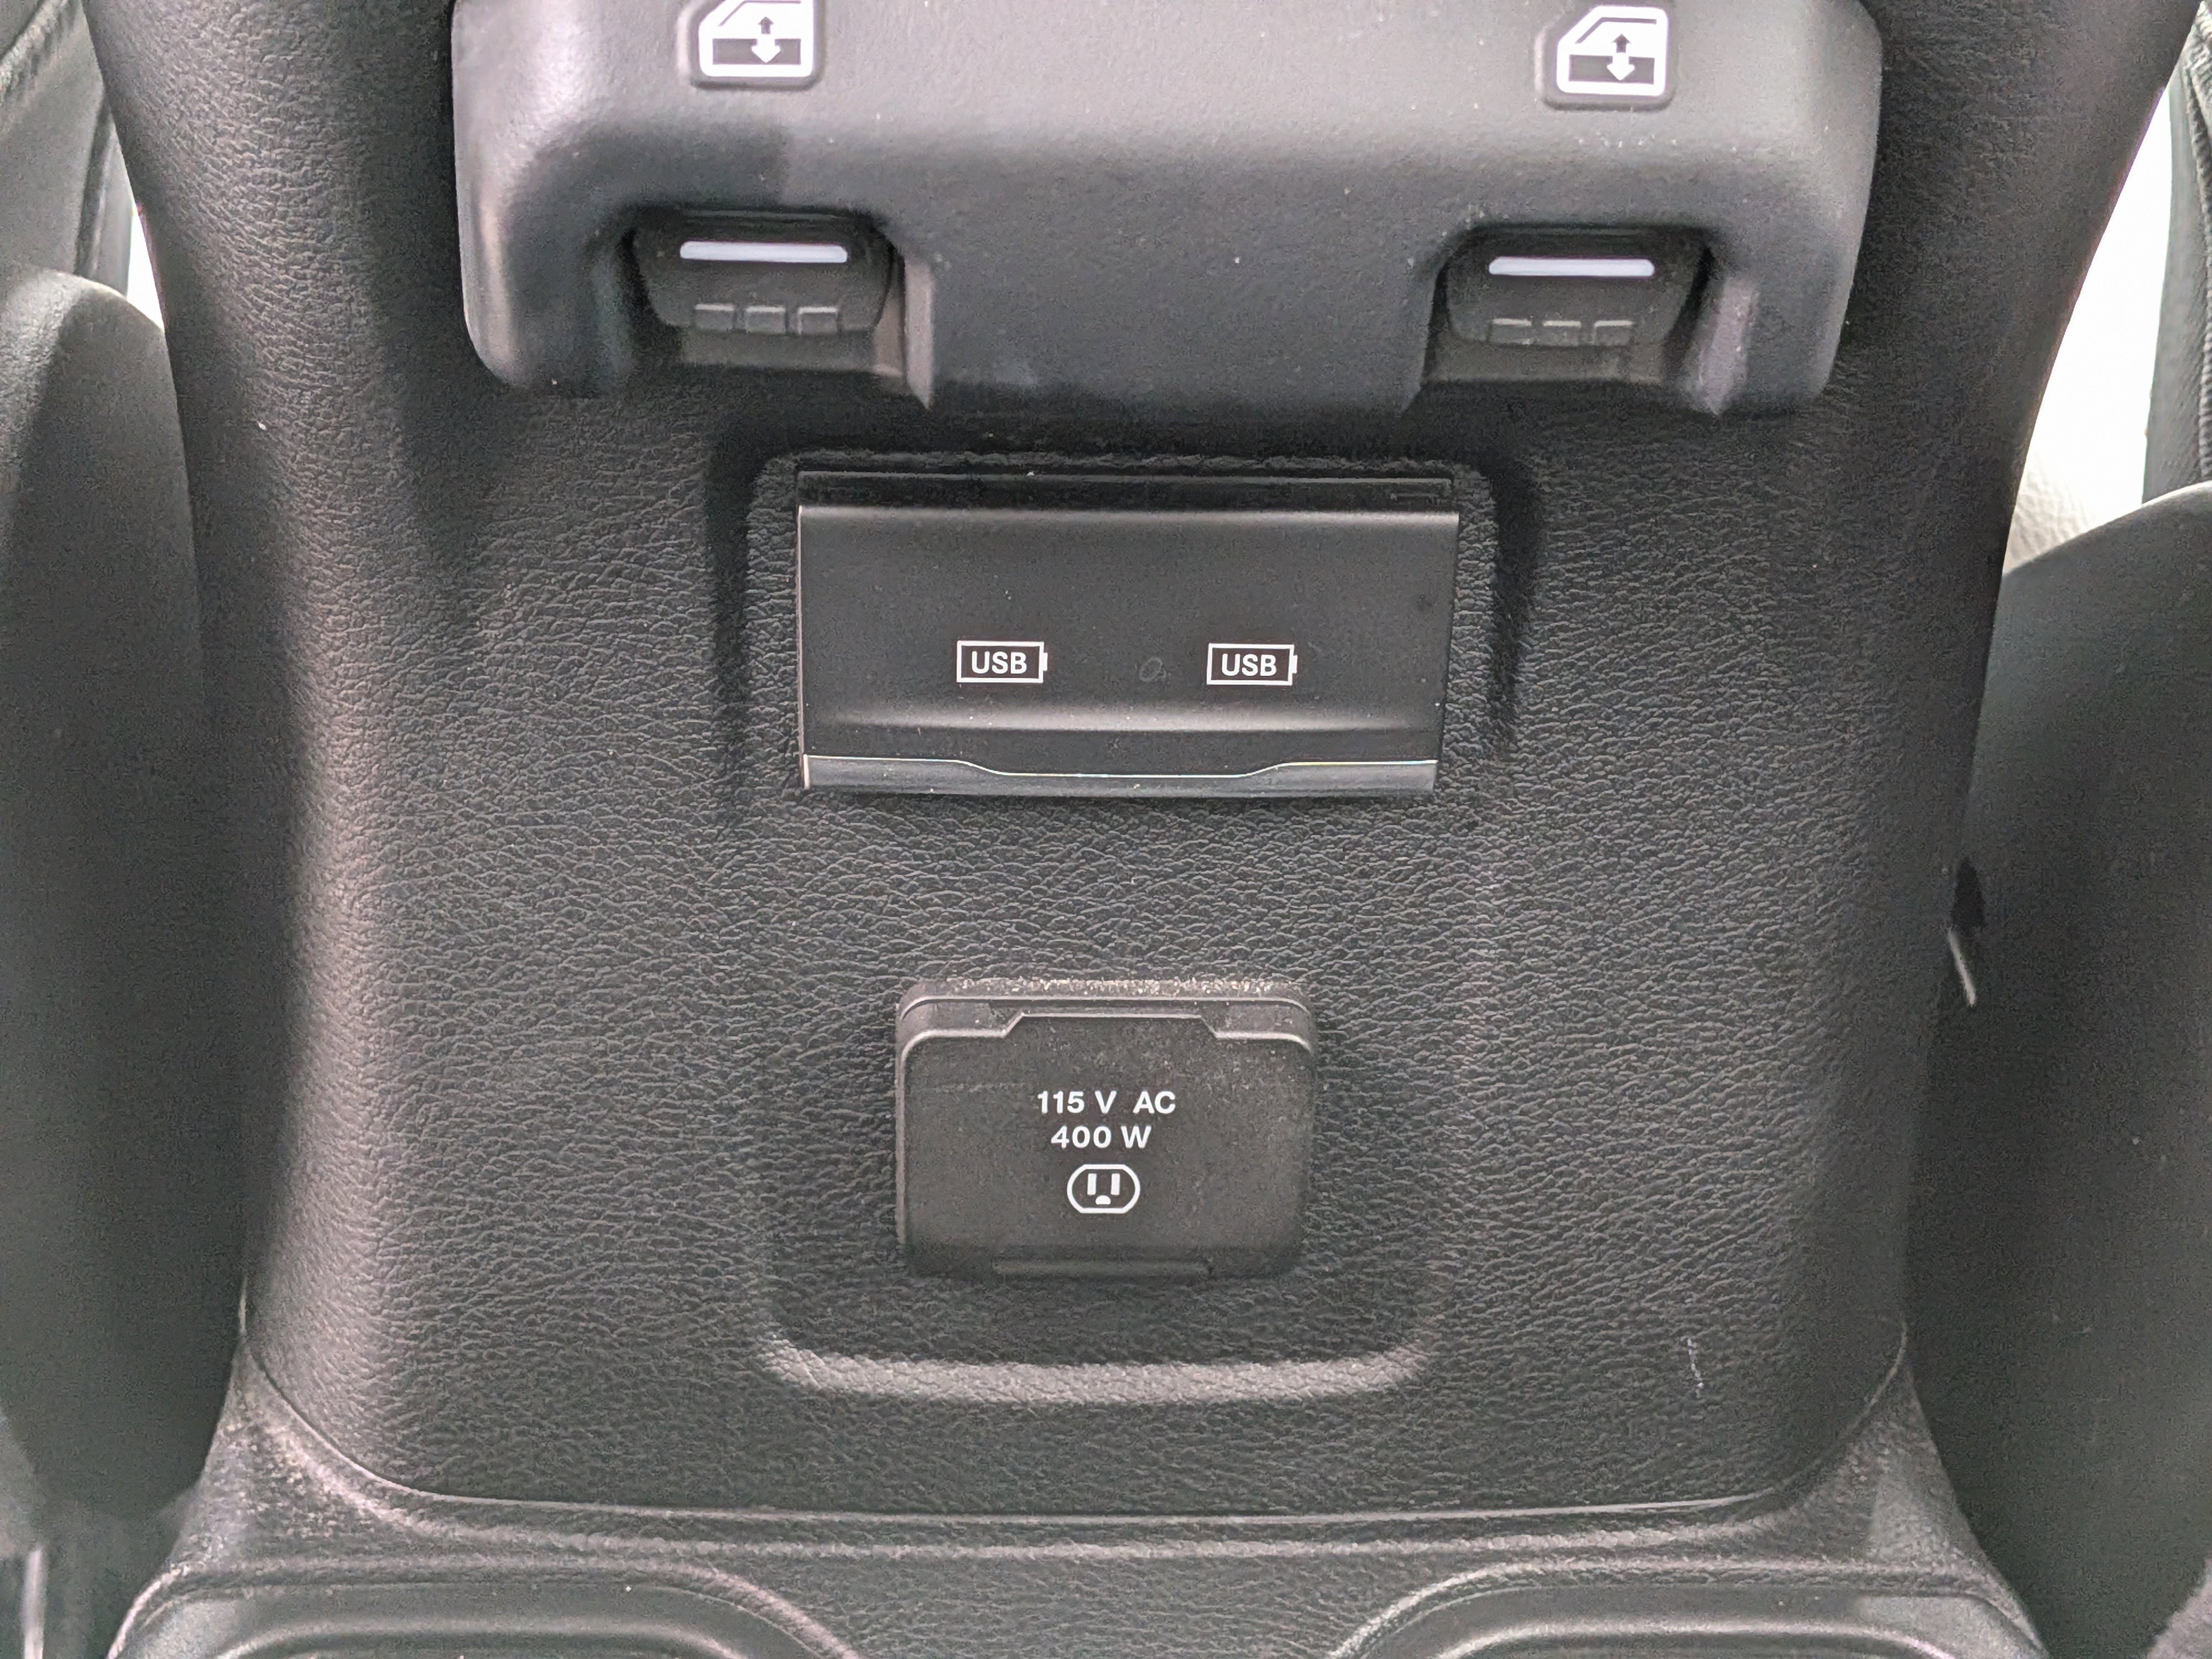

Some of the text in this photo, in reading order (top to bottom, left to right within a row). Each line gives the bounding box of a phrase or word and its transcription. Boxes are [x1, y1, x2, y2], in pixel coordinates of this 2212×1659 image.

[971, 650, 1027, 675] USB
[1221, 653, 1278, 677] USB
[1036, 1089, 1177, 1115] 115 V AC
[1050, 1125, 1152, 1149] 400 W
